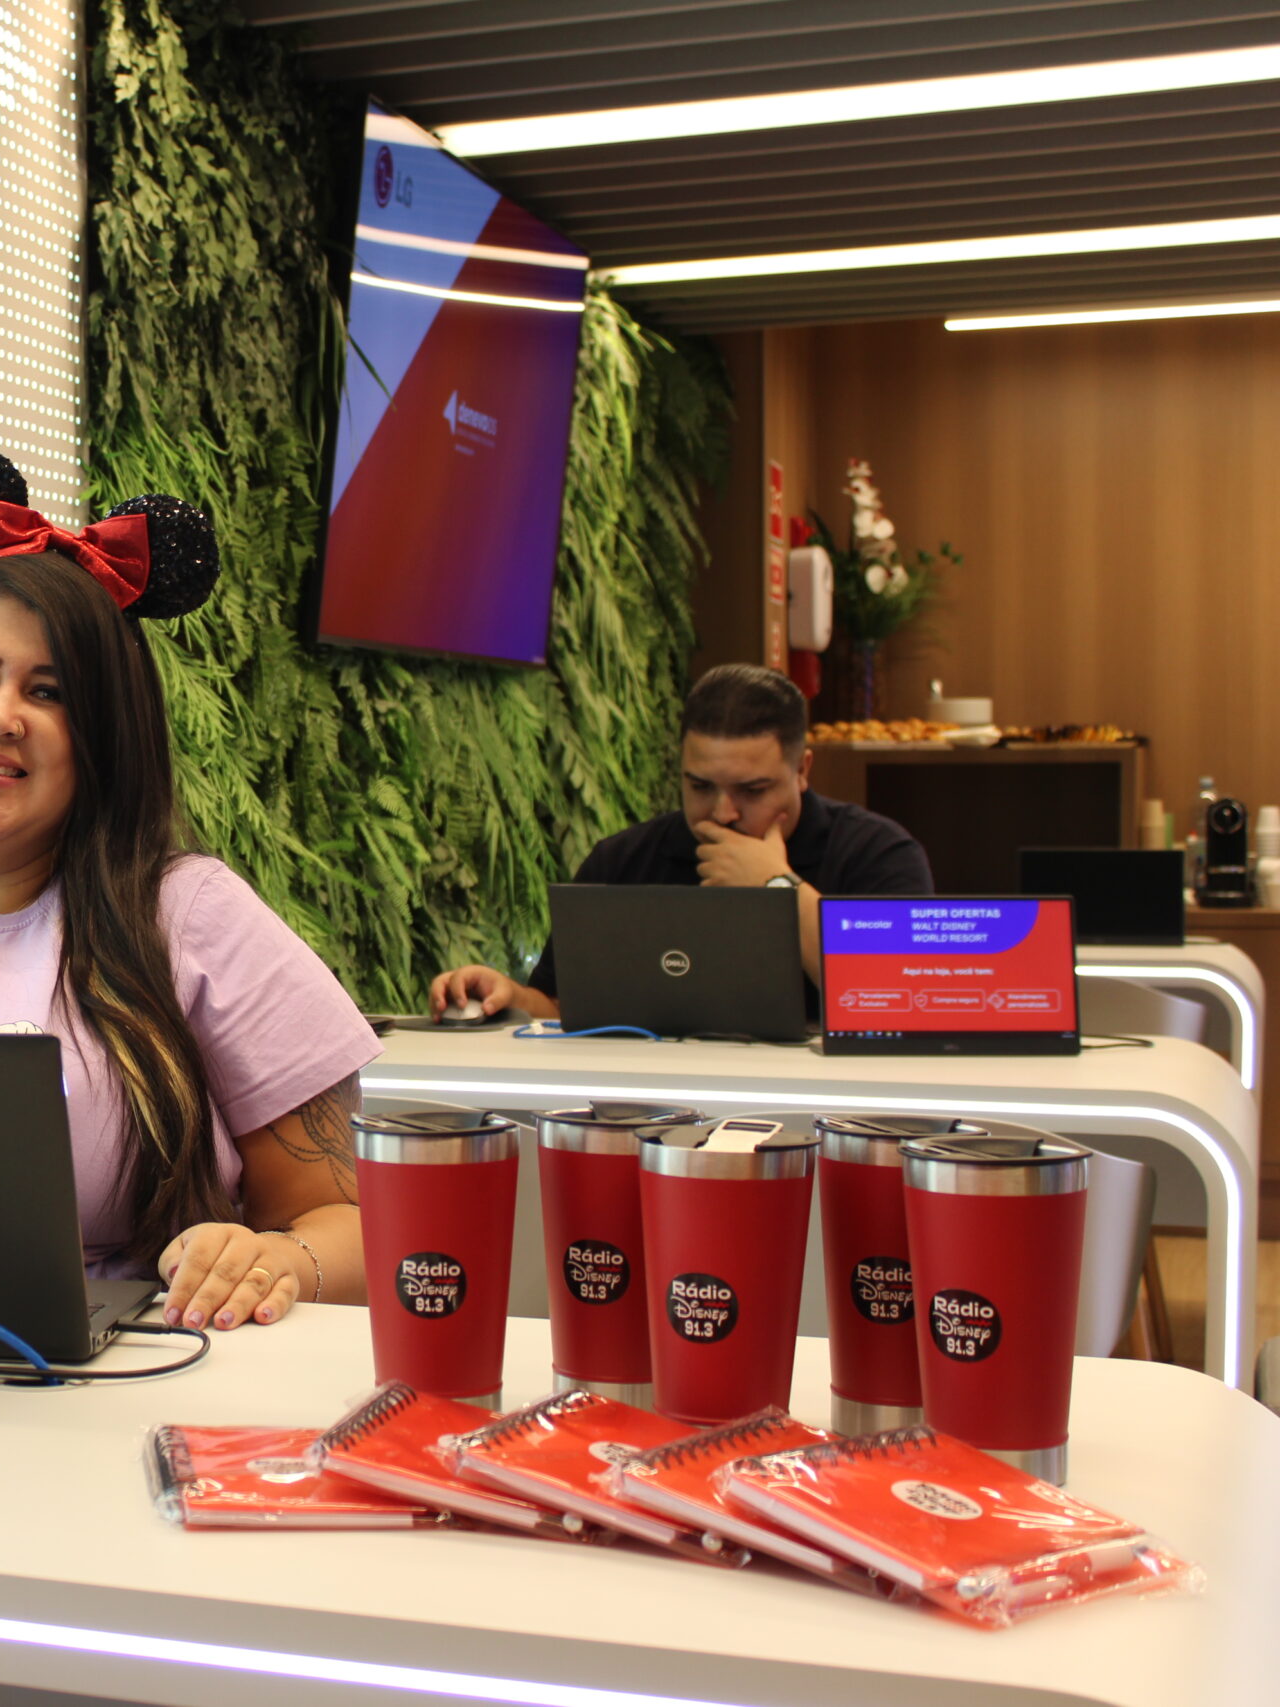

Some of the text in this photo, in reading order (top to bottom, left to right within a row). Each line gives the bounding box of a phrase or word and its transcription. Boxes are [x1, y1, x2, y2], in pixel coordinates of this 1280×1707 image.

[911, 908, 1001, 919] SUPER OFERTAS
[854, 920, 893, 930] decolar
[912, 922, 977, 931] WALT DISNEY
[912, 933, 988, 943] WORLD RESORT
[568, 1246, 624, 1265] Rádio
[402, 1260, 461, 1277] Rádio
[580, 1283, 607, 1300] 91.3
[672, 1280, 732, 1300] Rádio
[415, 1296, 444, 1312] 91.3
[870, 1302, 899, 1319] 91.3
[934, 1295, 994, 1319] Rádio
[685, 1319, 714, 1337] 91.3
[946, 1336, 976, 1356] 91.3
